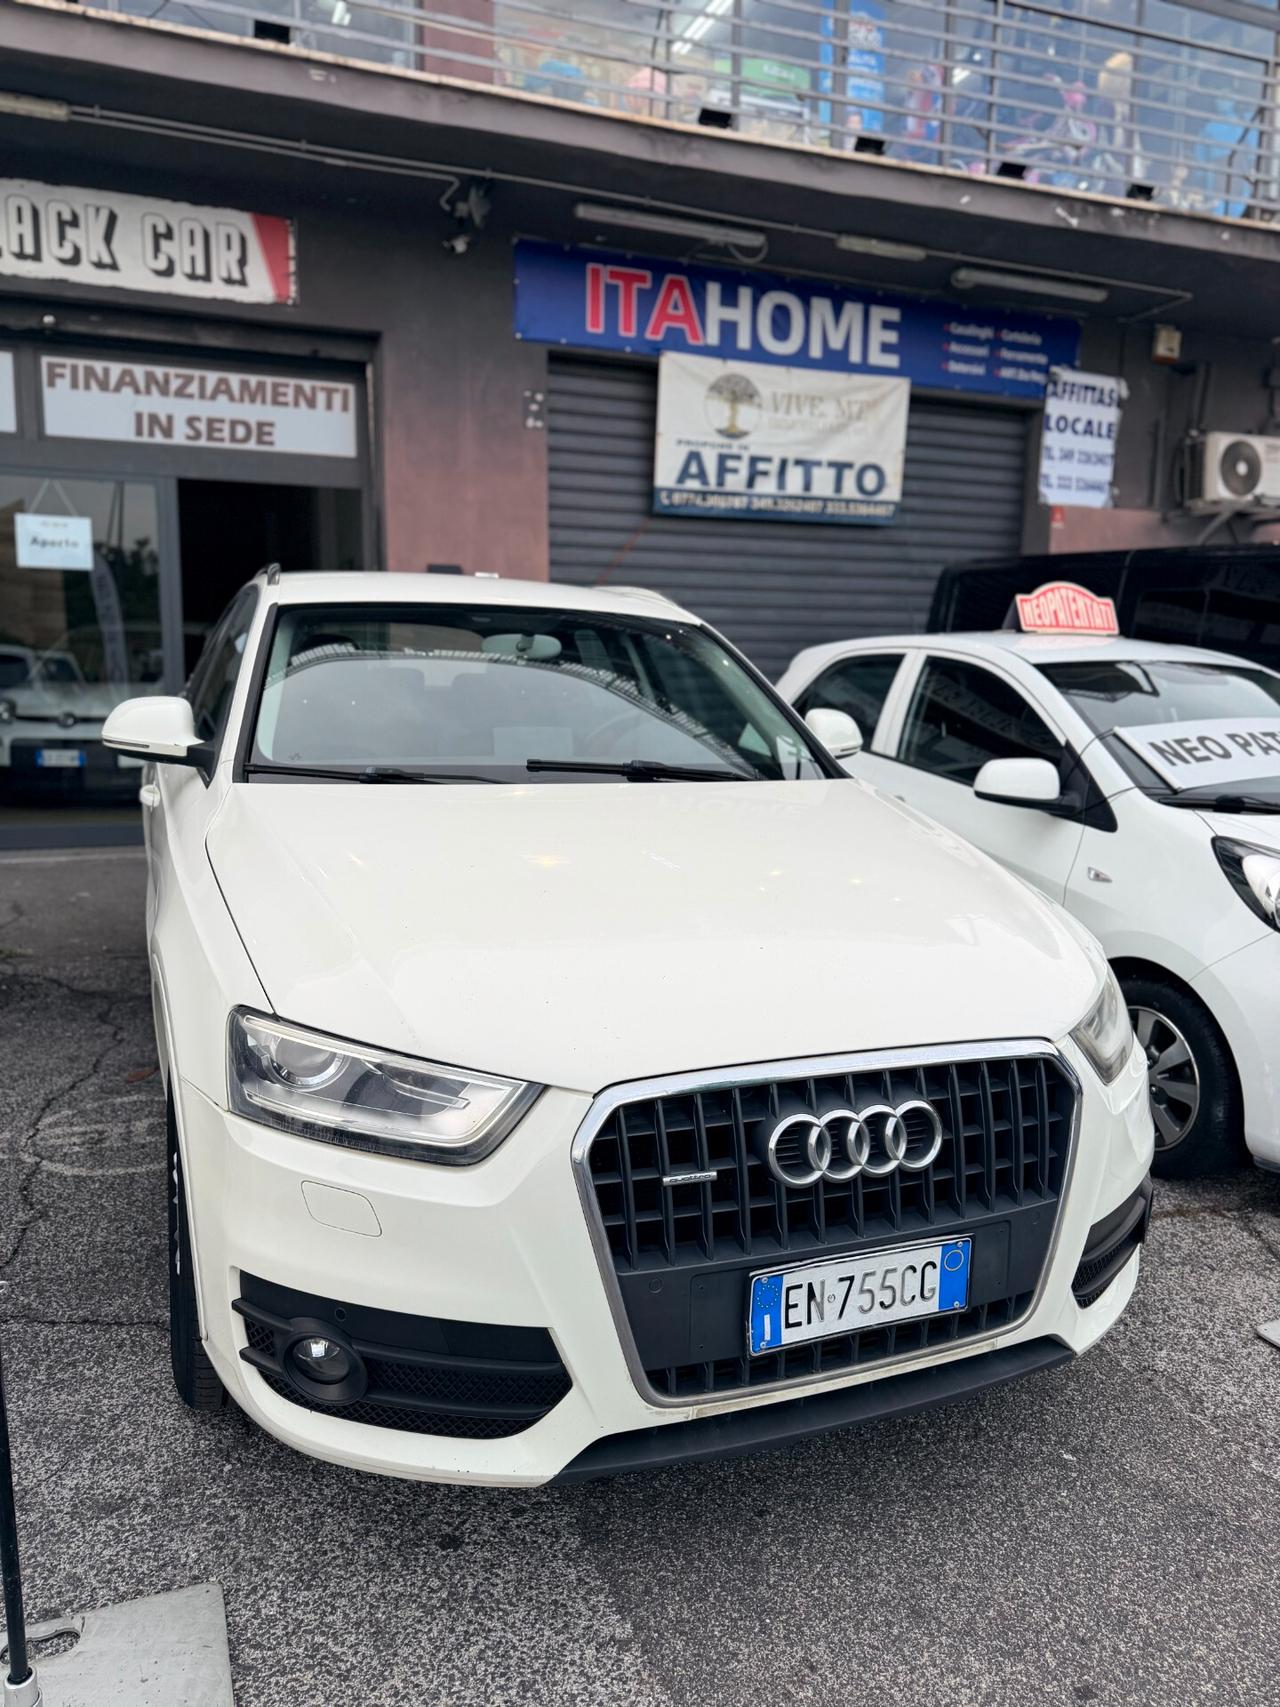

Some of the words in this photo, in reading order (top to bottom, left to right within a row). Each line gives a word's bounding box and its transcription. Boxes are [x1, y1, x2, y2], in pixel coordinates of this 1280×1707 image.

[0, 193, 120, 271] ACK
[142, 211, 249, 287] CAR
[587, 264, 901, 368] ITAHOME
[46, 362, 351, 413] FINANZIAMENTI
[135, 411, 174, 438] IN
[185, 416, 275, 446] SEDE
[675, 450, 886, 497] AFFITTO
[1147, 735, 1233, 767] NEO
[1224, 731, 1280, 757] PAT
[784, 1279, 826, 1329] EN
[837, 1260, 938, 1321] 755CG
